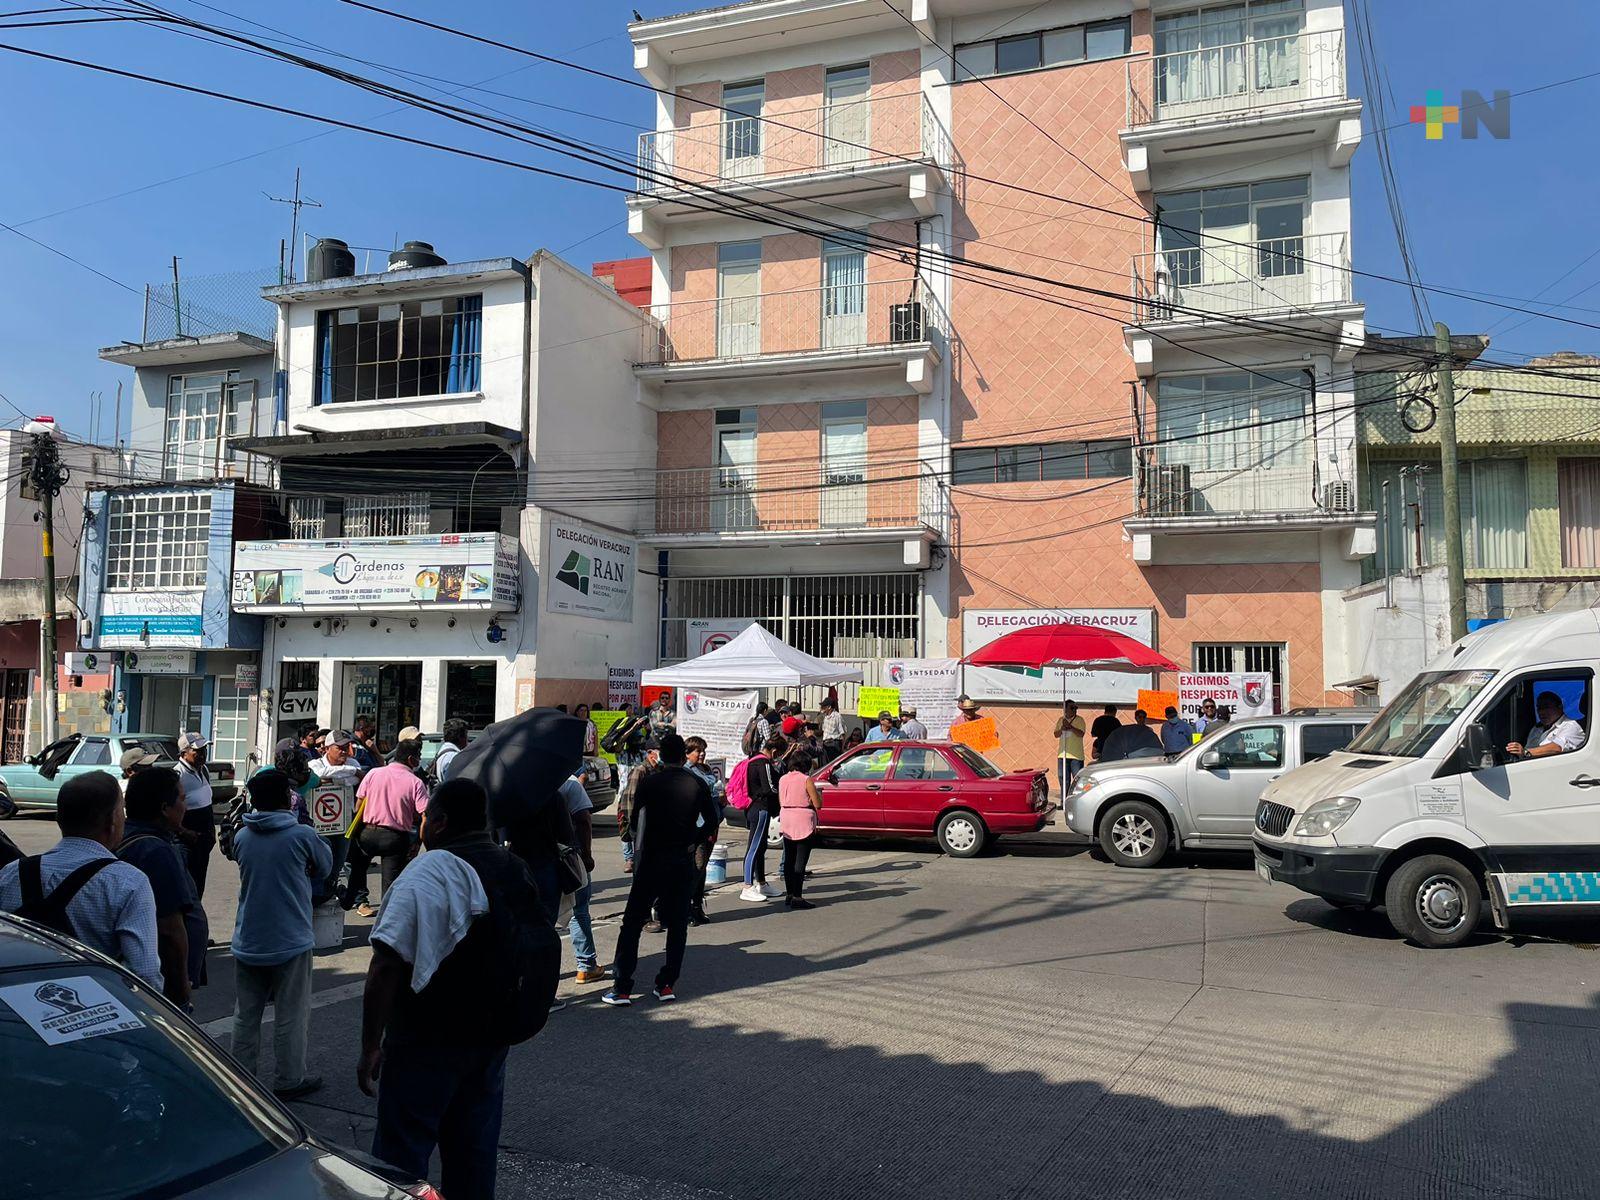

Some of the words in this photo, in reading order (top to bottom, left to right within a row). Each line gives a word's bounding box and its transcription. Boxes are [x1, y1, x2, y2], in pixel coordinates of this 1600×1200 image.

[556, 527, 599, 547] DELEGACIÓN
[599, 538, 631, 555] VERACRUZ
[333, 552, 405, 584] Cárdenas
[593, 557, 625, 582] RAN
[977, 614, 1060, 626] DELEGACIÓN
[1064, 615, 1138, 626] VERACRUZ
[609, 667, 635, 678] EXIGIMOS
[909, 669, 956, 677] SNTSEDATU
[609, 680, 638, 690] RESPUESTA
[1180, 675, 1230, 686] EXIGIMOS
[609, 694, 619, 703] POR
[620, 694, 637, 703] PARTE
[1181, 689, 1239, 700] RESPUESTA
[704, 699, 752, 710] SNTSEDATU
[42, 1004, 118, 1030] RESISTENCIA
